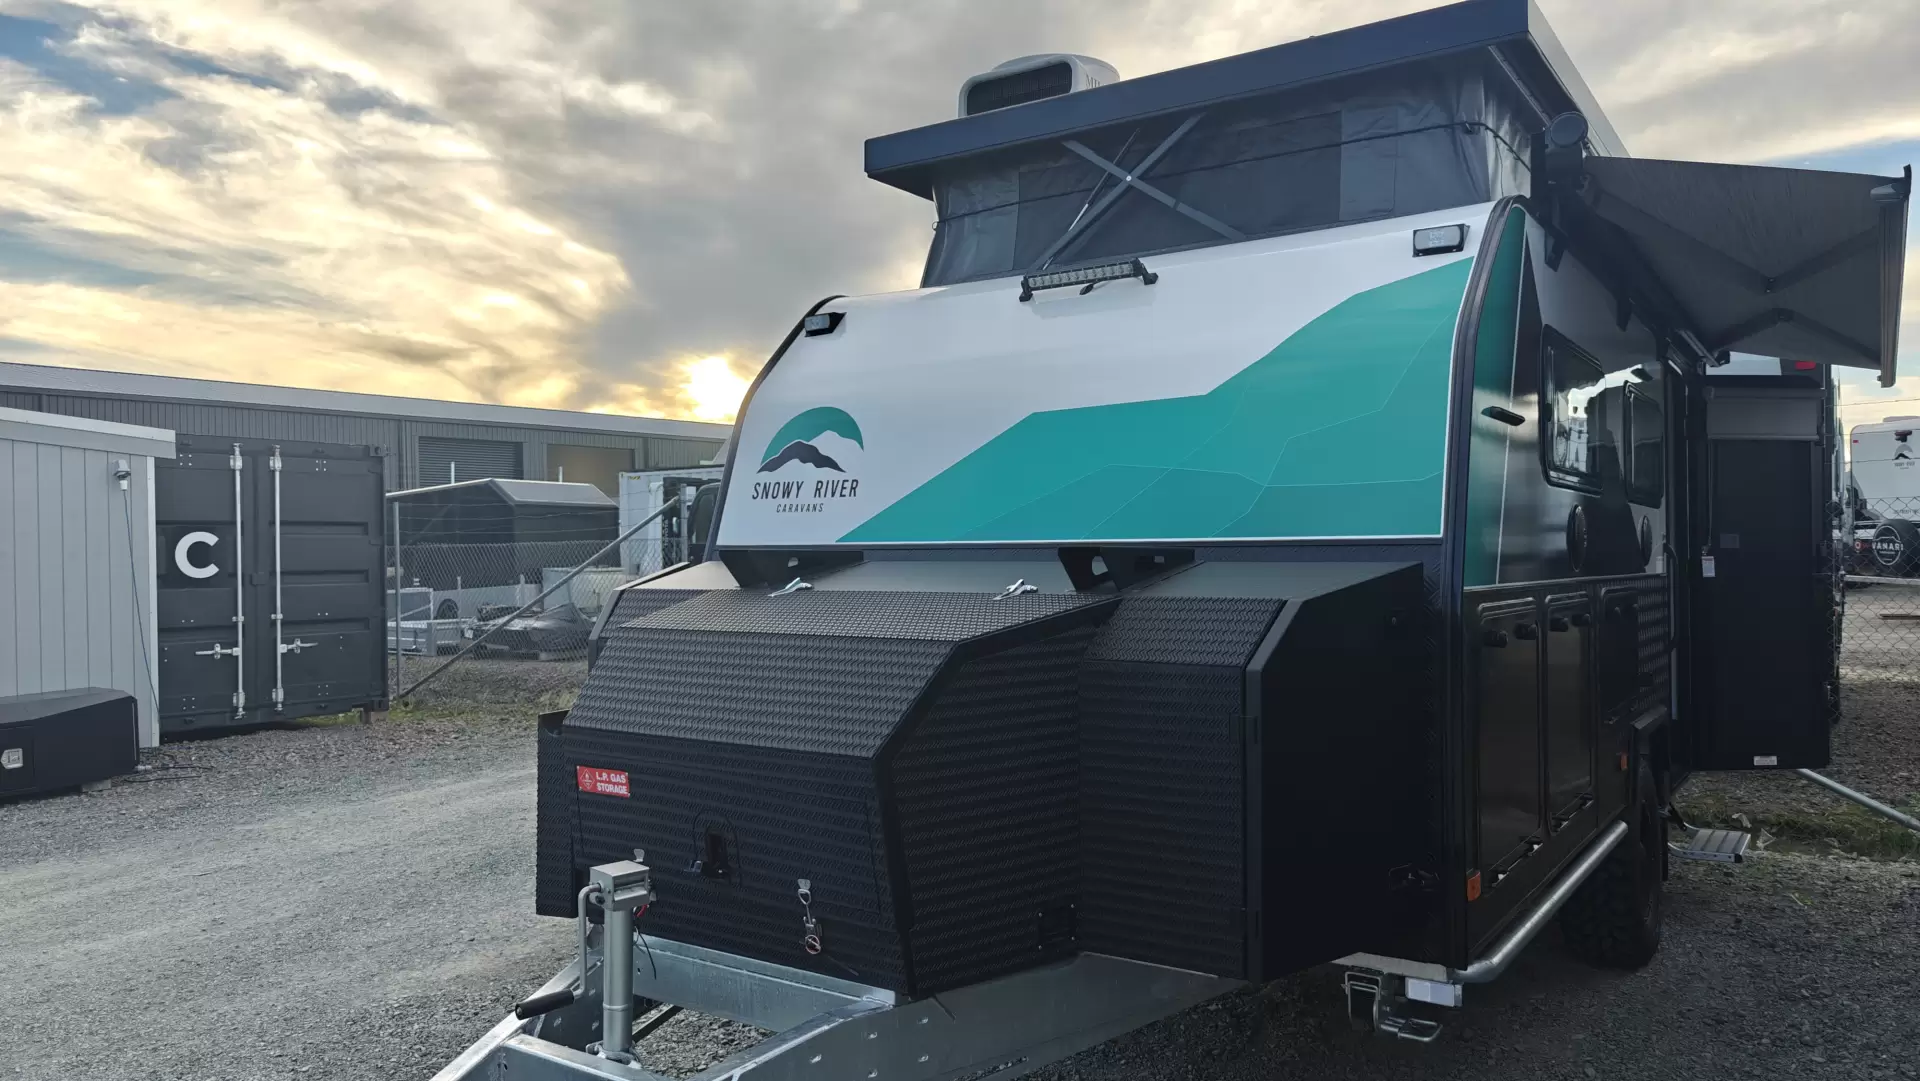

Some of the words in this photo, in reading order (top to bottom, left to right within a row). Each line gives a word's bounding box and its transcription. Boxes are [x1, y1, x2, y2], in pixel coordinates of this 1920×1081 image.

[752, 480, 804, 500] SNOWY
[813, 479, 859, 498] RIVER
[776, 503, 824, 513] CARAVANS
[174, 531, 220, 579] C
[610, 774, 626, 783] GAS
[597, 783, 628, 794] STORAGE
